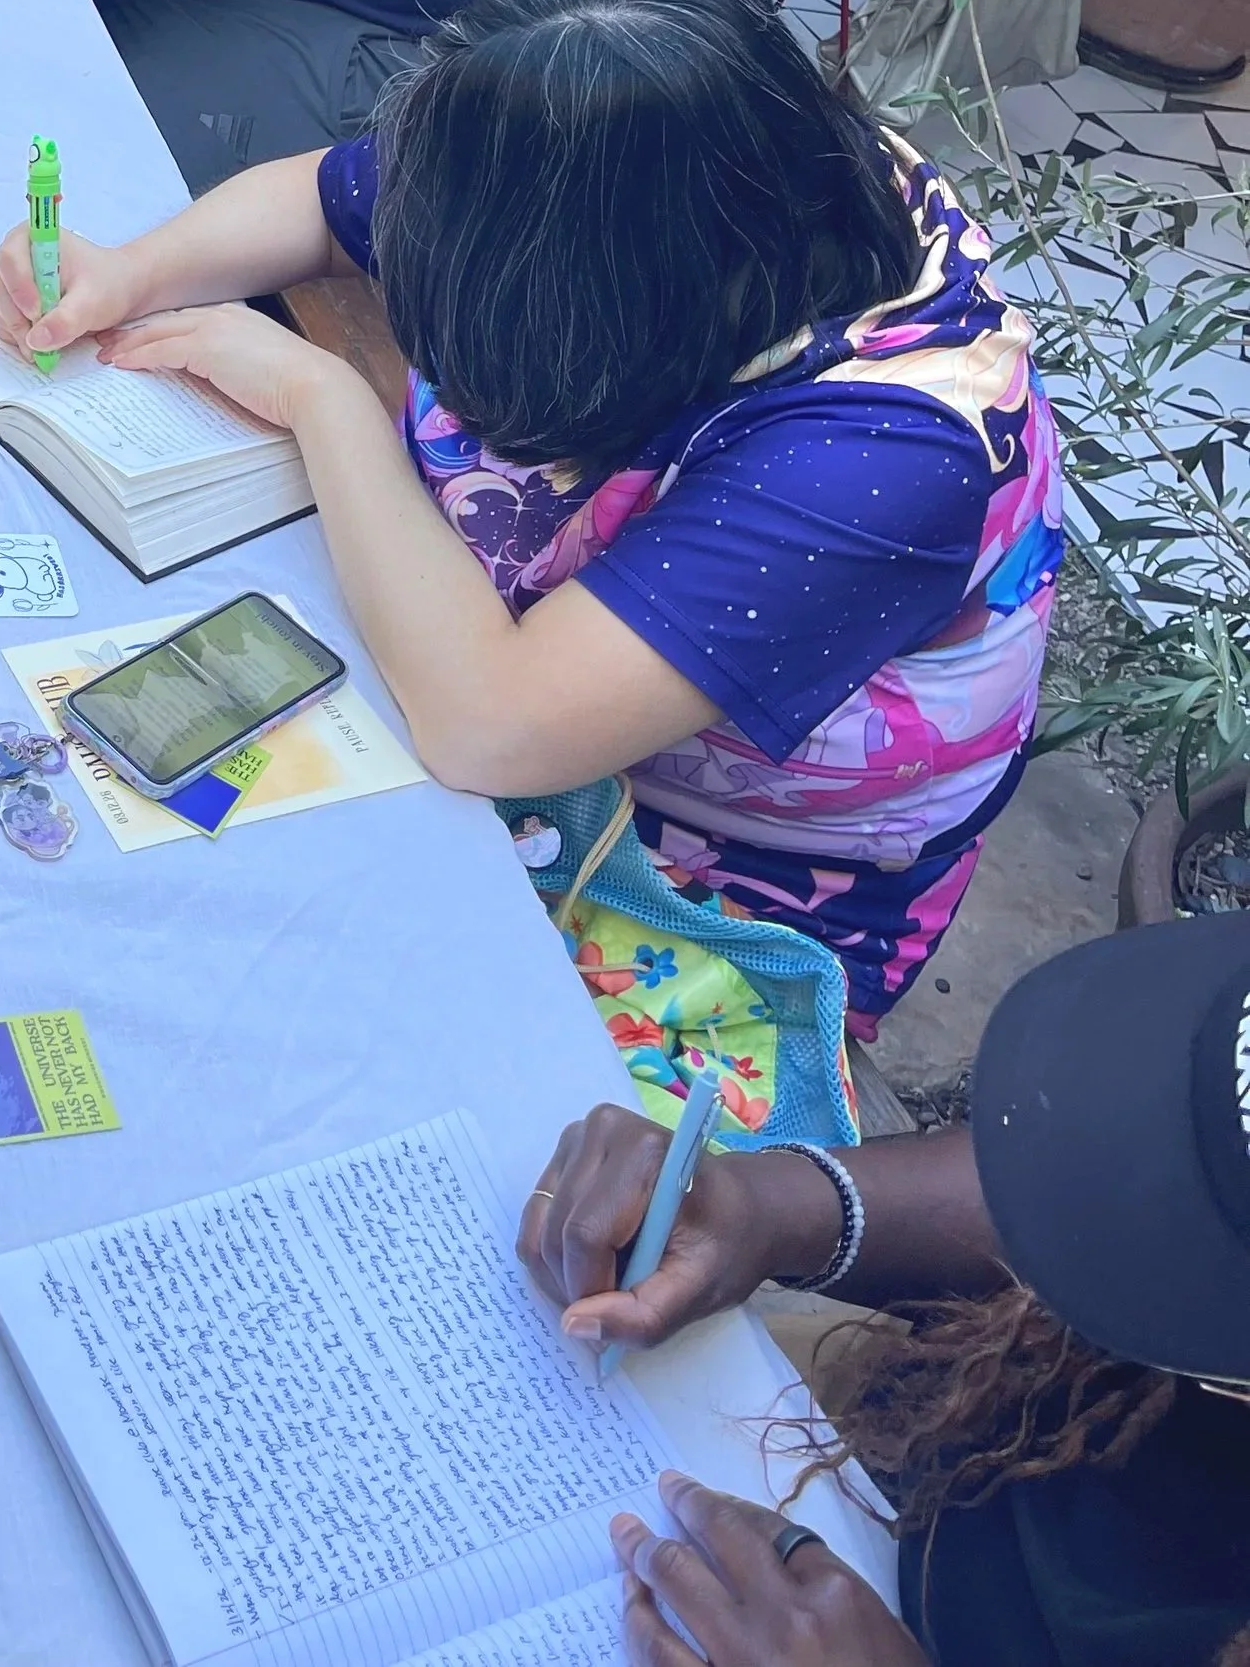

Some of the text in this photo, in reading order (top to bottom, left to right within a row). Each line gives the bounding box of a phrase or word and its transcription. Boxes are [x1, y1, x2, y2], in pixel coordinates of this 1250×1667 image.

[288, 639, 302, 653] in
[300, 647, 328, 675] Stay
[223, 761, 251, 783] THE
[228, 753, 257, 775] HAS
[52, 1015, 77, 1057] BACK
[21, 1015, 57, 1088] UNIVERSE
[36, 1013, 88, 1129] HAS NEVER NOT
[69, 1061, 88, 1087] MY
[50, 1098, 72, 1130] THE
[81, 1091, 104, 1128] HAD
